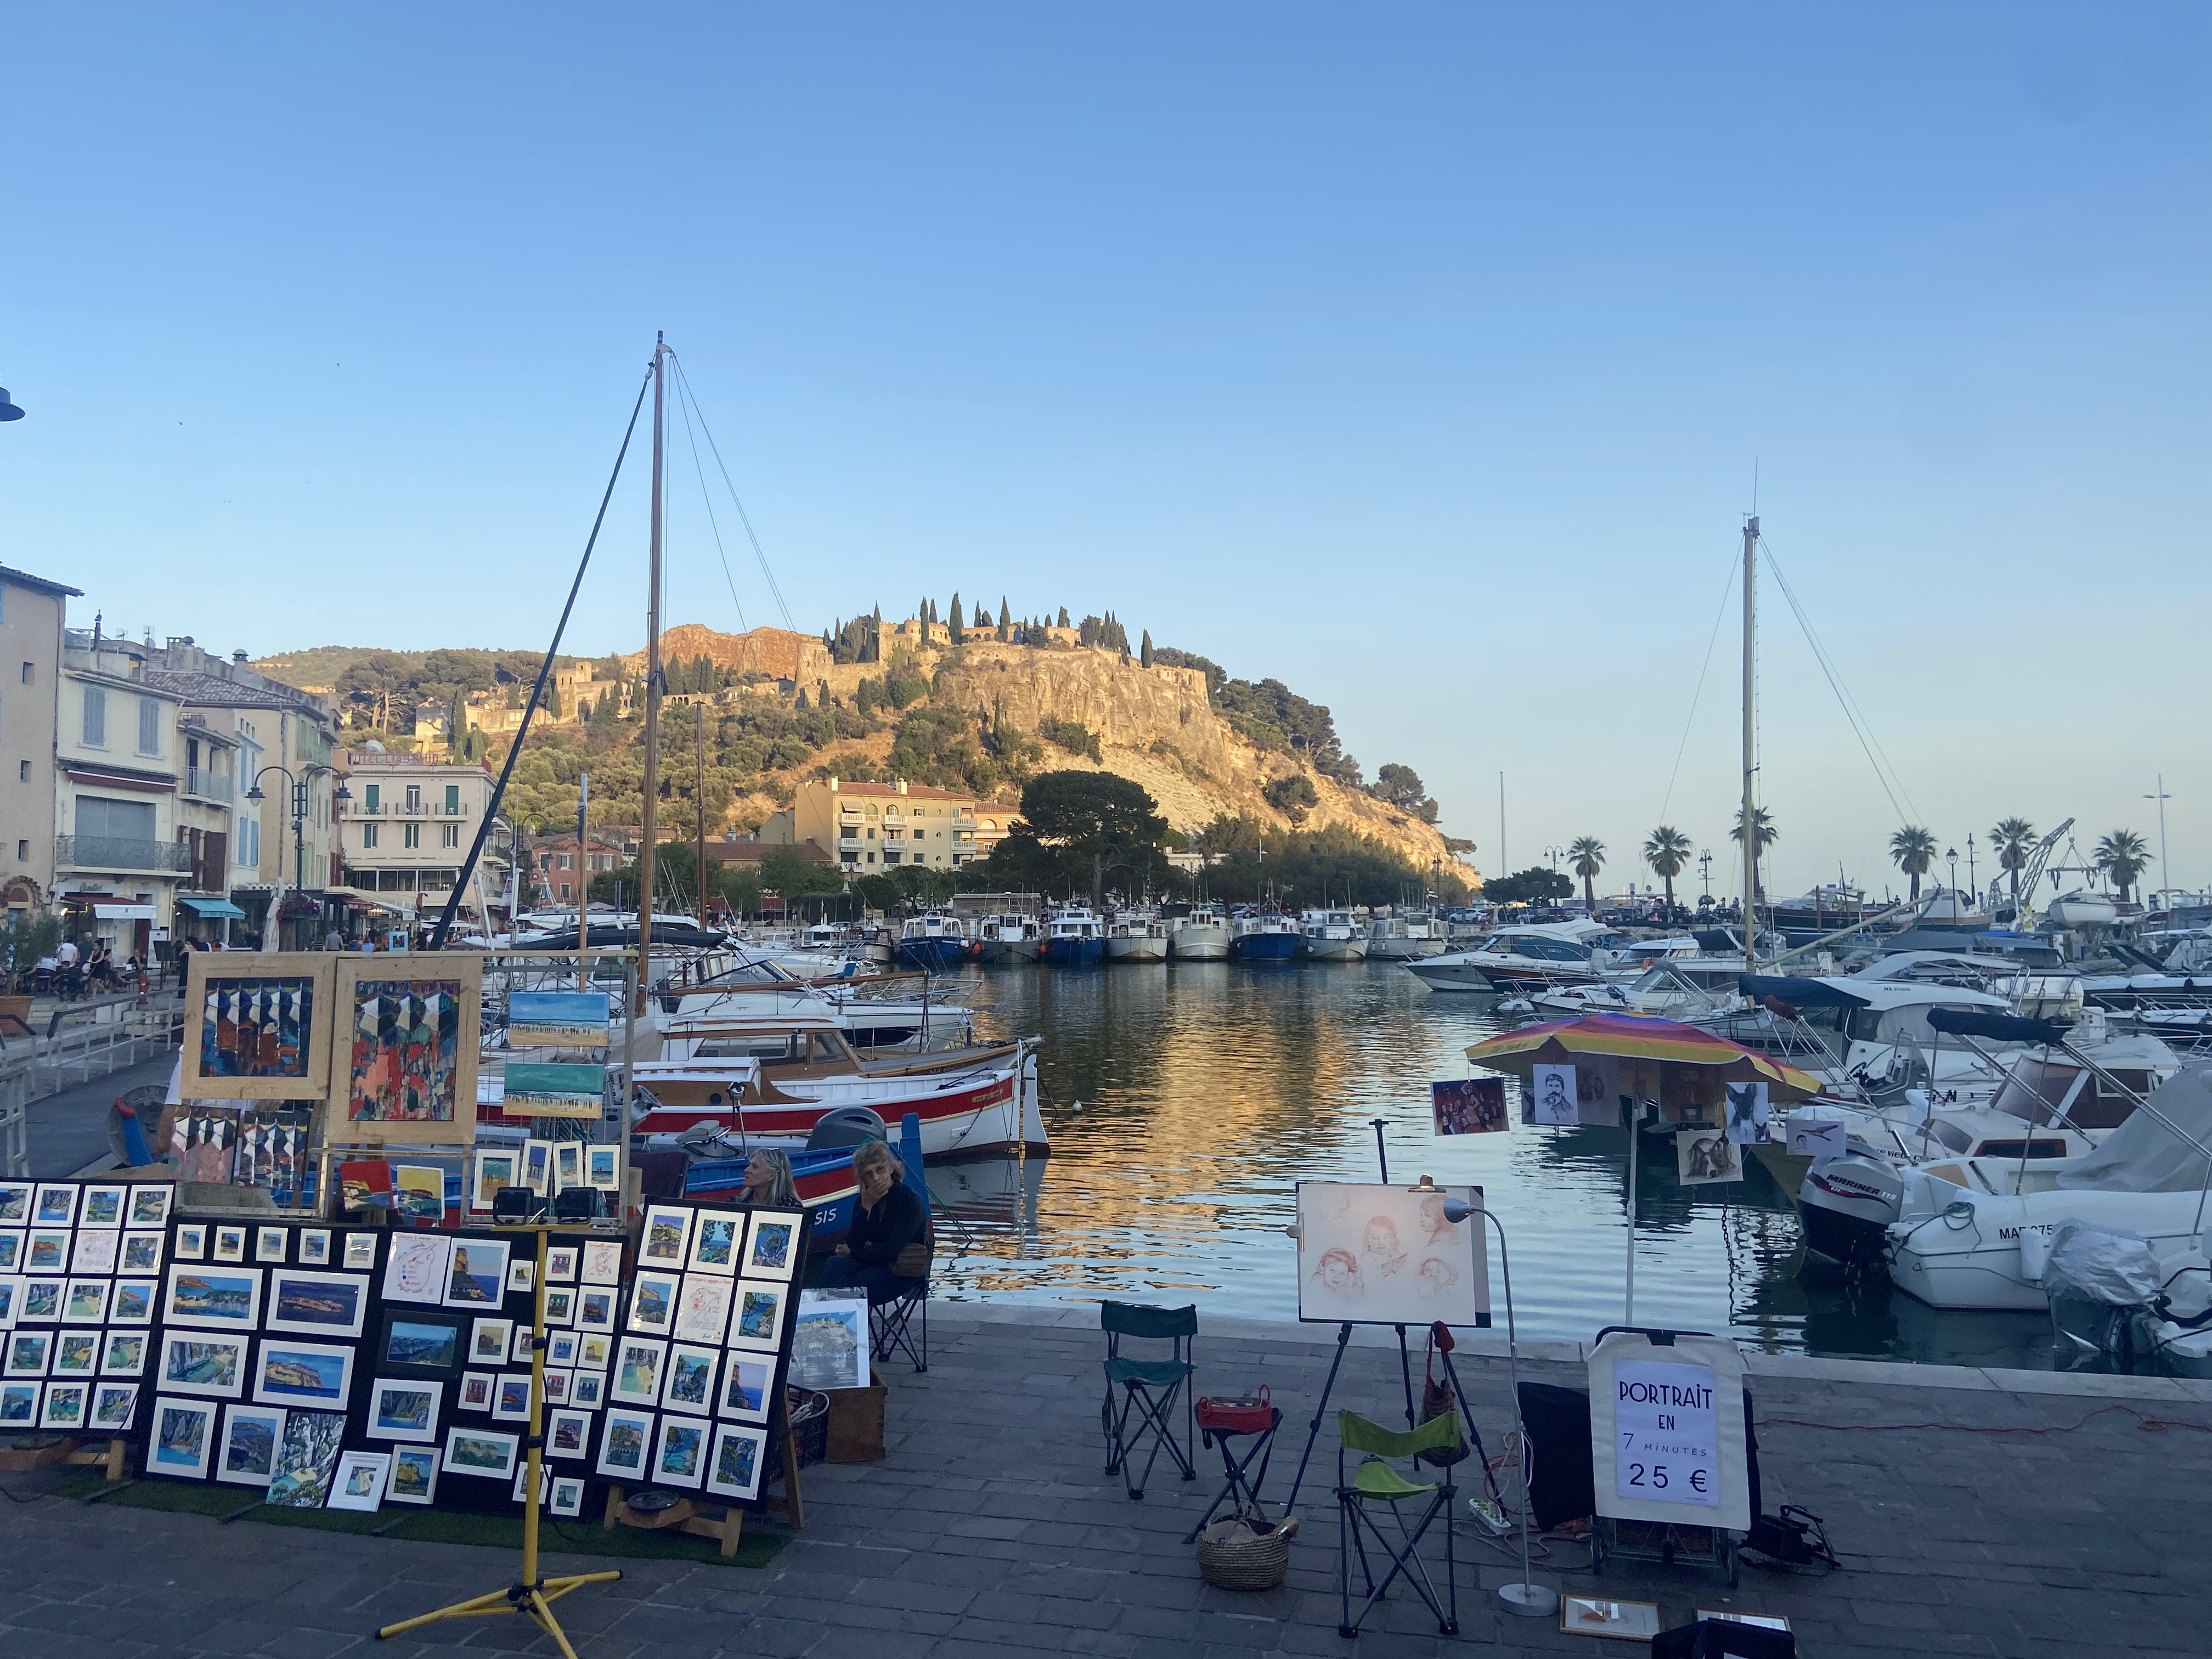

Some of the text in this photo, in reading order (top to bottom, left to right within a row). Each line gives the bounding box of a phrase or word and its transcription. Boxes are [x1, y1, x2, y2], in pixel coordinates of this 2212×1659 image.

[1826, 1173, 1880, 1195] MARINER
[1881, 1192, 1897, 1200] 115
[1619, 1381, 1713, 1409] PORTRAIT
[1658, 1414, 1675, 1430] EN
[1622, 1432, 1707, 1457] 7 MINUTES
[1629, 1463, 1707, 1493] 25 €
